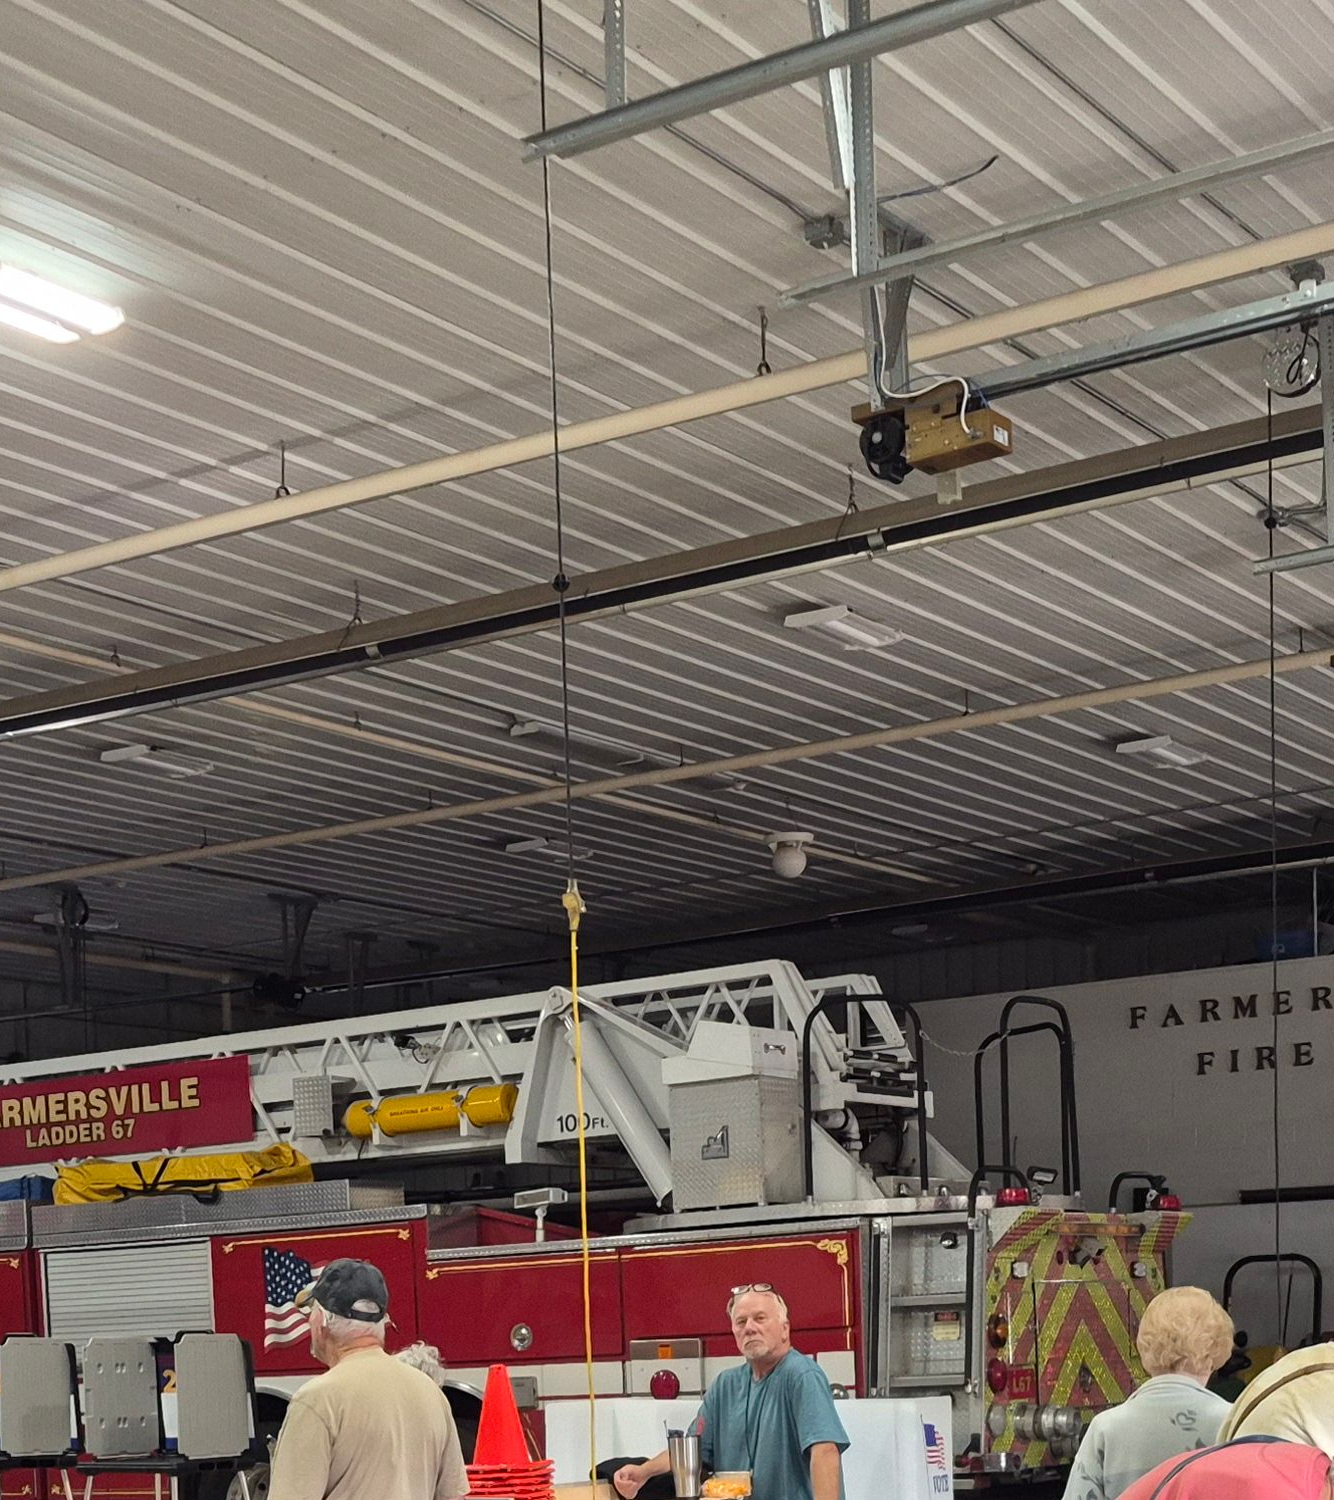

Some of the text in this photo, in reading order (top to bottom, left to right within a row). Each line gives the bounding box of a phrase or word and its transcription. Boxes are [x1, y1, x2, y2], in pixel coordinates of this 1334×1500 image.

[1196, 1042, 1315, 1075] FIRE
[25, 1118, 136, 1148] LADDER 67
[163, 1369, 177, 1394] 2
[932, 1473, 949, 1494] VOTE
